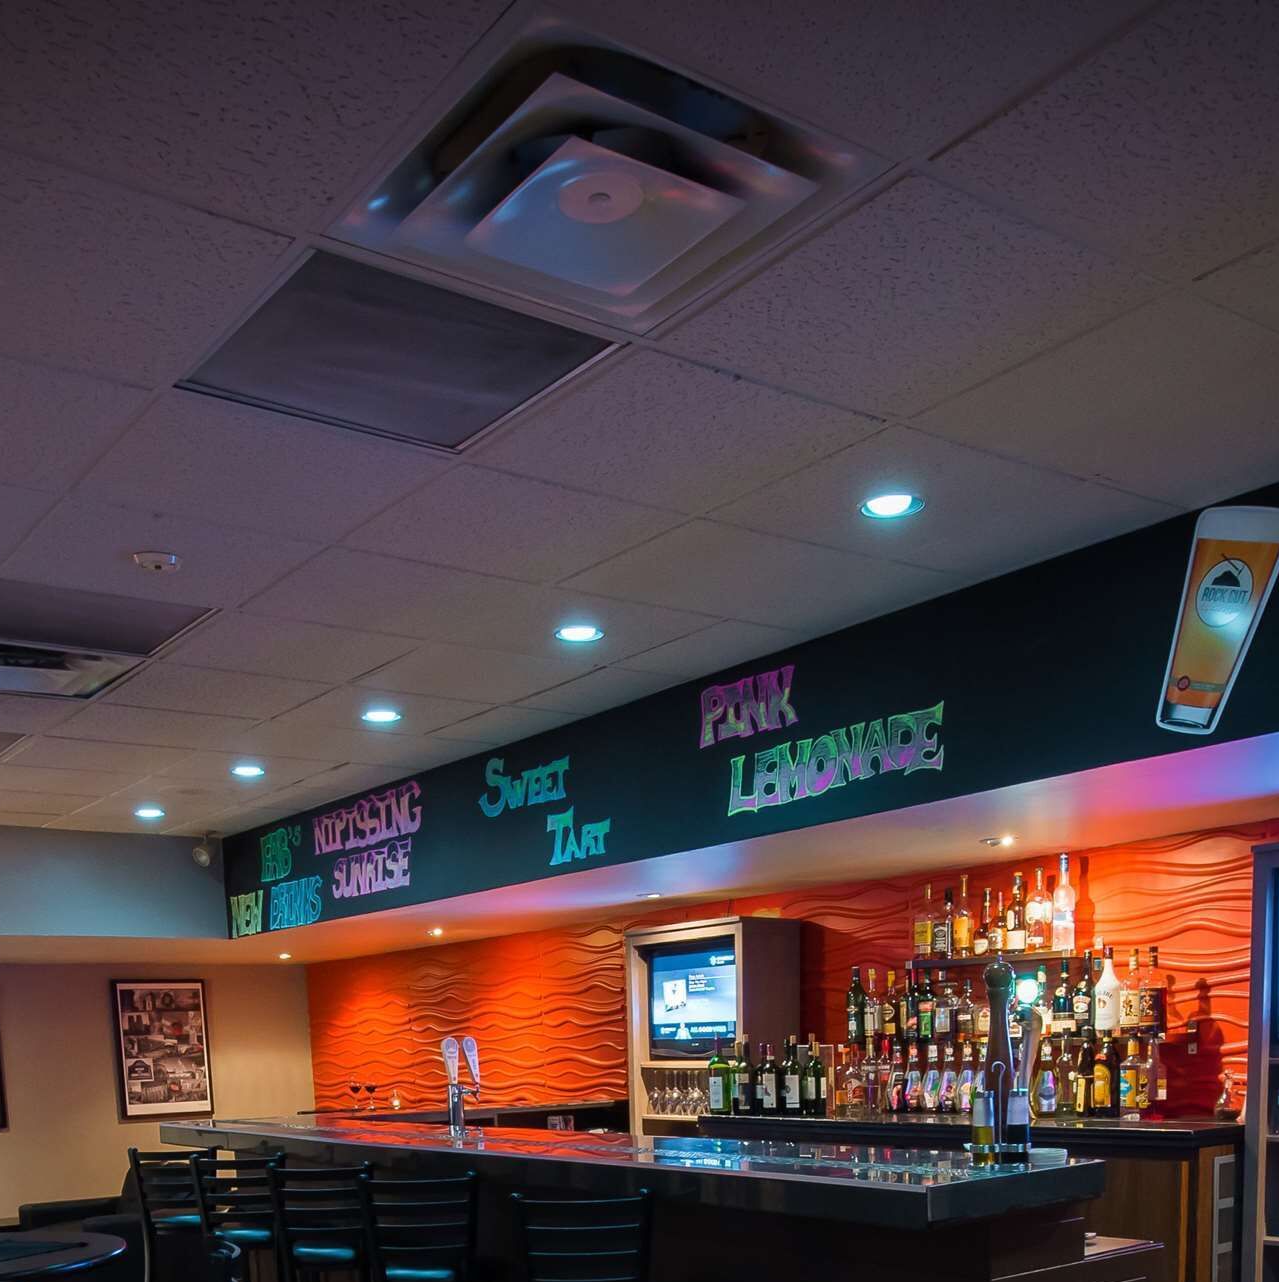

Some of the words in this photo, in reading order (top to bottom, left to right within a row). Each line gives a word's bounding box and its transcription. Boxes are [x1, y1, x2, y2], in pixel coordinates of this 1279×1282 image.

[700, 664, 799, 750] PINK
[727, 700, 944, 817] LEMONADE
[312, 779, 423, 856] NIPISSING
[332, 836, 412, 900] SUNRISE
[229, 889, 264, 939] NEW
